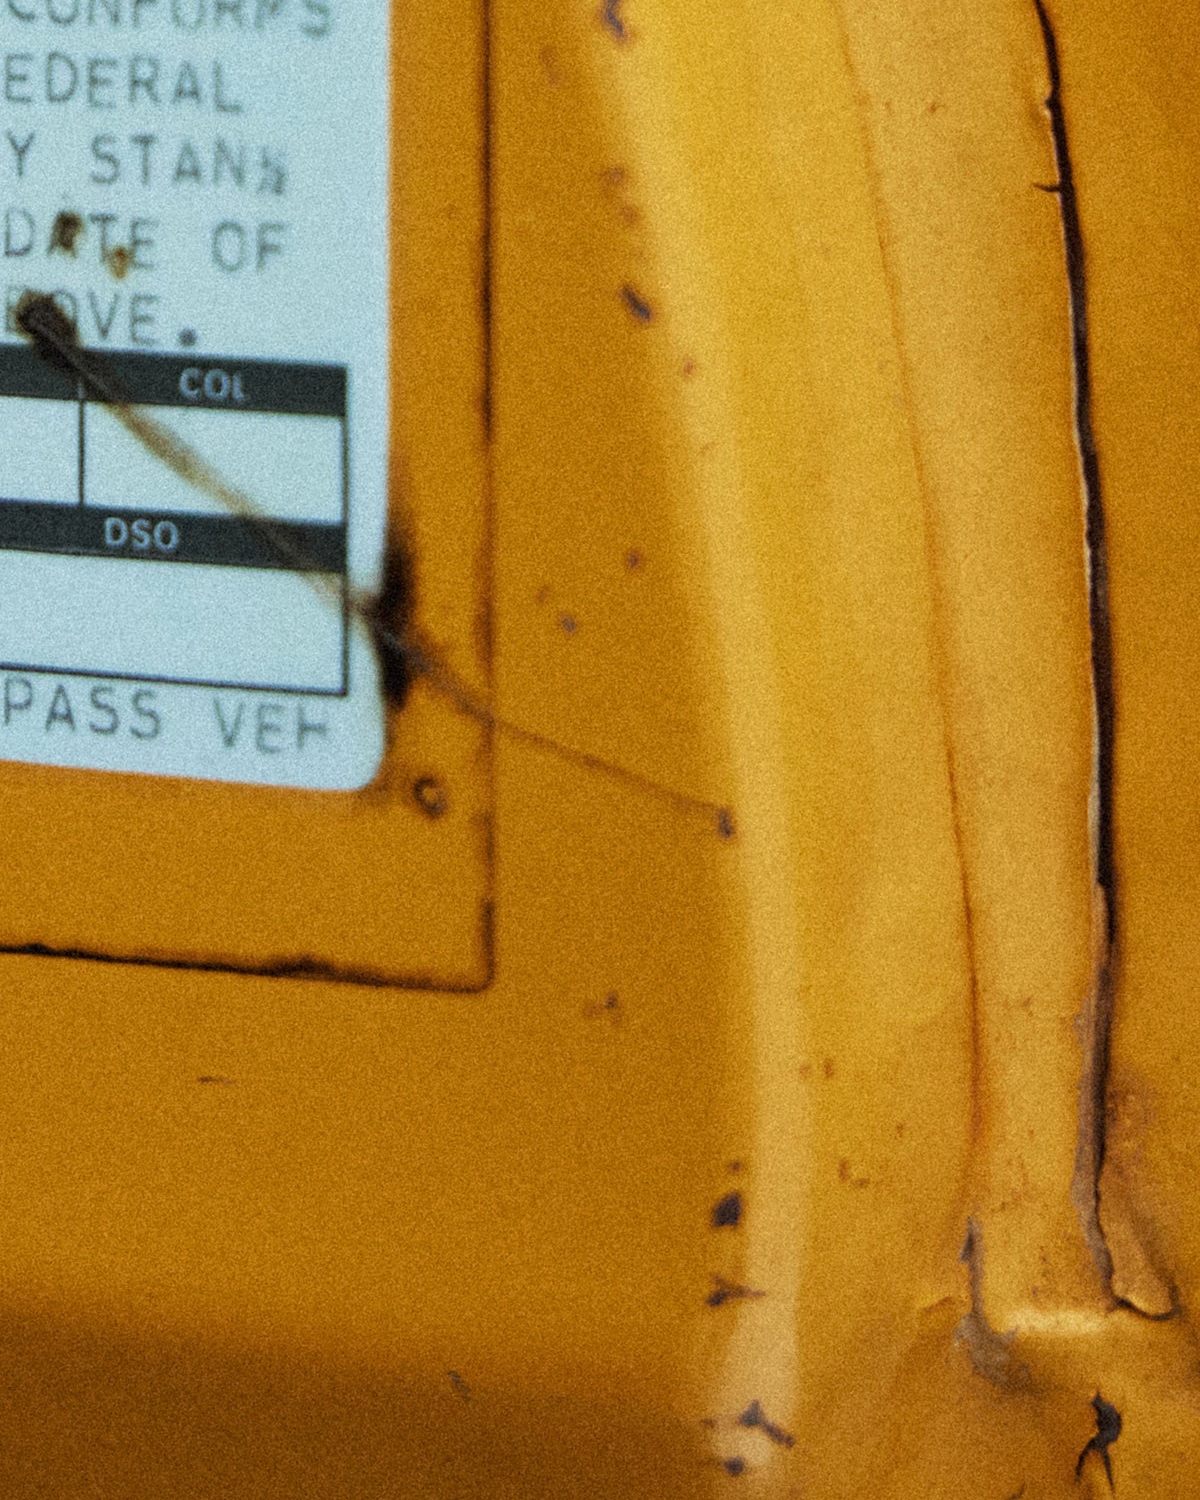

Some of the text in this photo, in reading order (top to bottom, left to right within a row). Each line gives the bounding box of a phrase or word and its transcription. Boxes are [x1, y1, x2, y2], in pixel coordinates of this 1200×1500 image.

[211, 220, 288, 273] OF
[179, 368, 249, 400] COL
[104, 516, 180, 551] DSO
[3, 677, 162, 740] PASS
